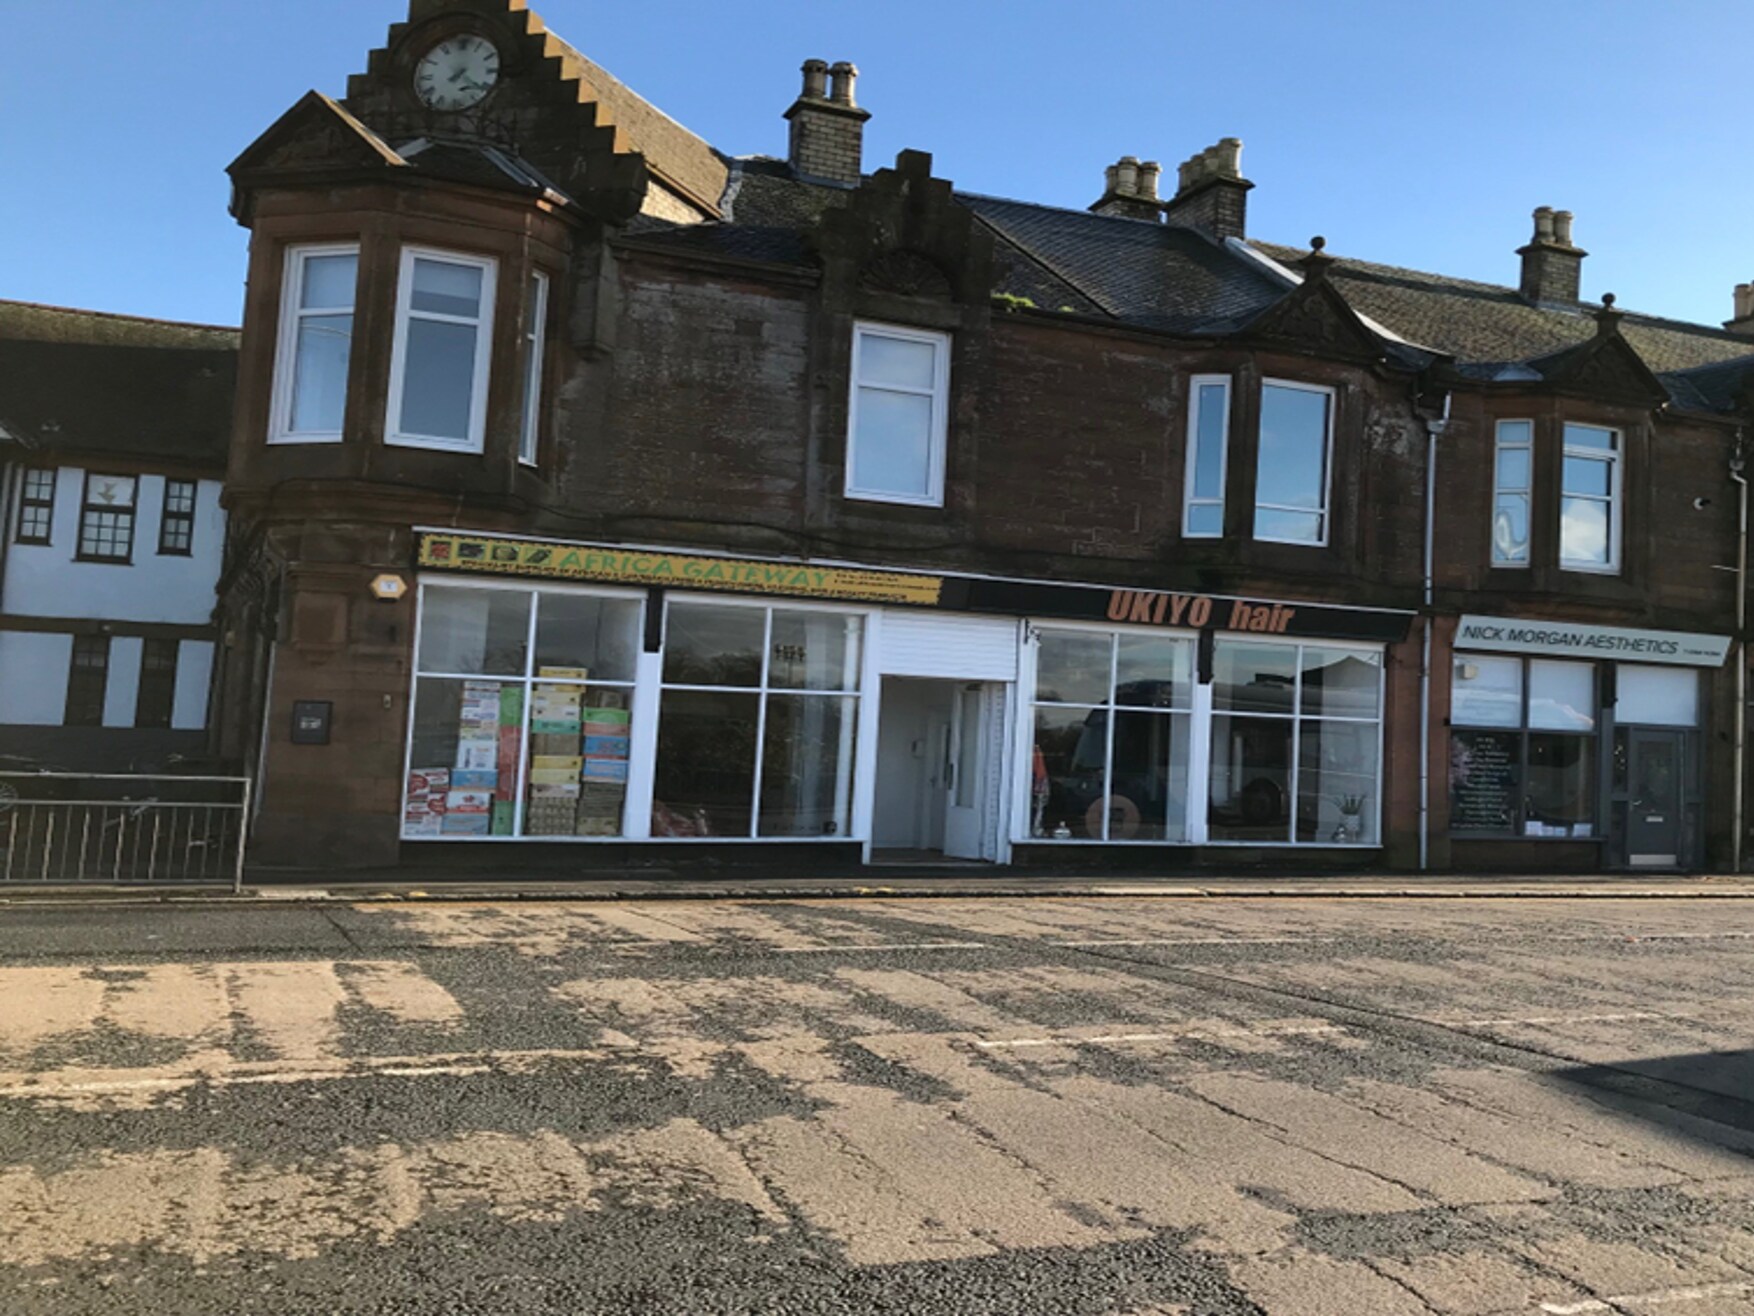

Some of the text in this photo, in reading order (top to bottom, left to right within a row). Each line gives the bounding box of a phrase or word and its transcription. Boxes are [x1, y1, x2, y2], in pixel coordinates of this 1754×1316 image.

[559, 551, 672, 575] AFRICA
[683, 562, 830, 586] GATEWAY
[1108, 590, 1295, 632] UKIYO hair
[1462, 625, 1504, 641] NICK
[1506, 629, 1583, 648] MORGAN
[1584, 635, 1678, 654] AESTHETICS
